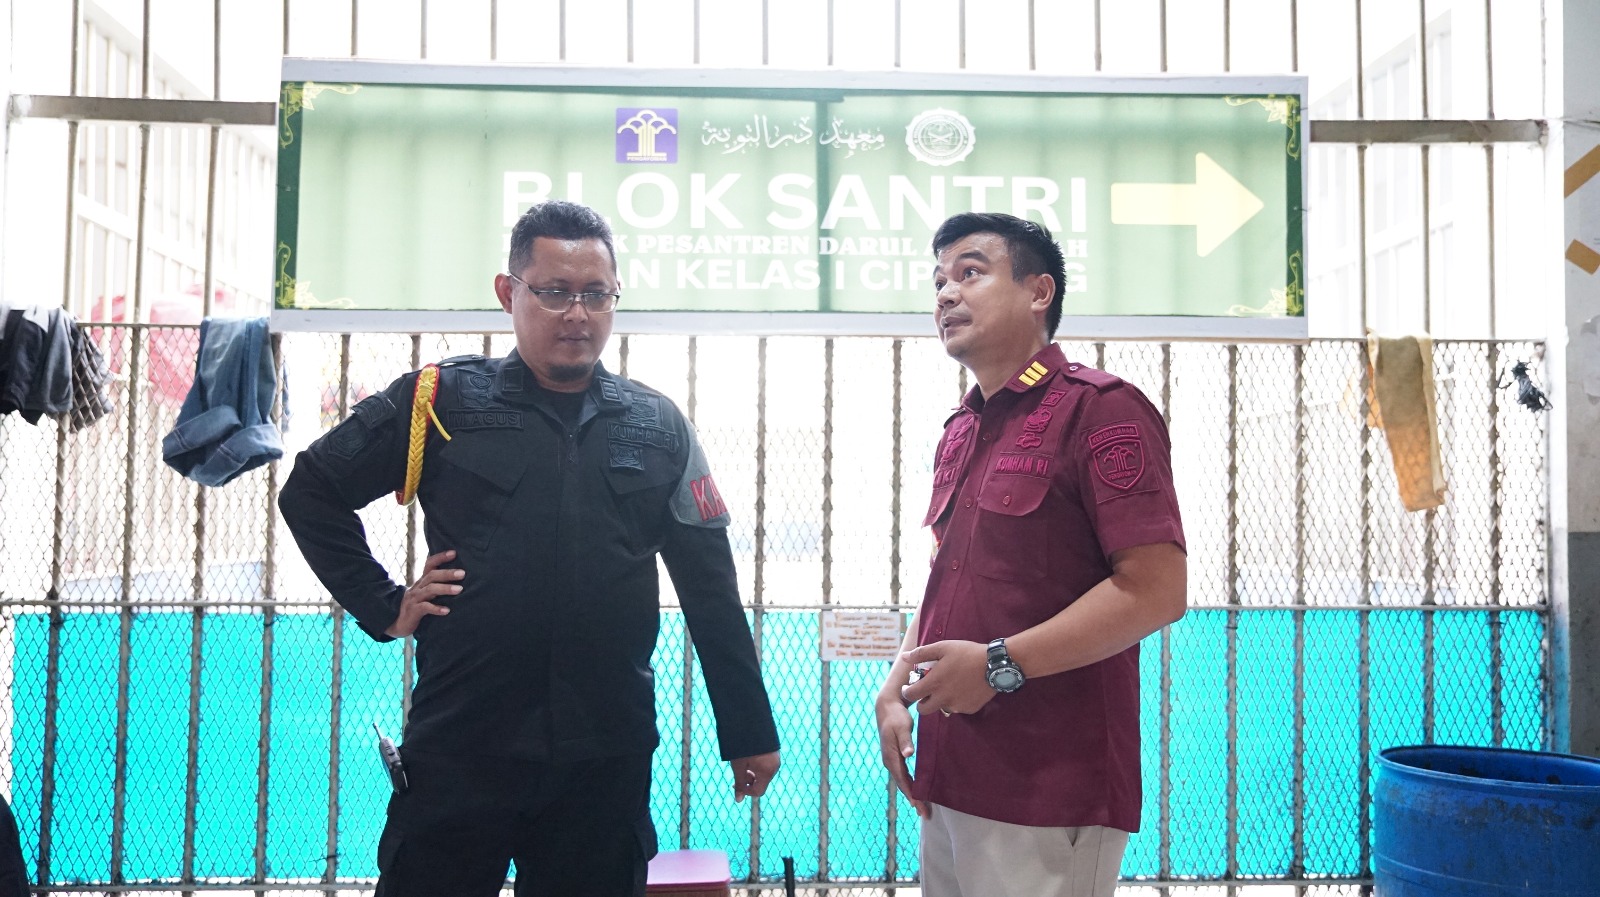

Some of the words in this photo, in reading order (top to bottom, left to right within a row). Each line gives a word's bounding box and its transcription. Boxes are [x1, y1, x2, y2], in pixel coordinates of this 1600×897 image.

[766, 173, 1087, 233] SANTRI
[637, 235, 810, 254] PESANTREN
[819, 236, 918, 256] DARUL
[677, 258, 821, 290] KELAS
[835, 260, 844, 290] I
[472, 412, 519, 427] AGUS
